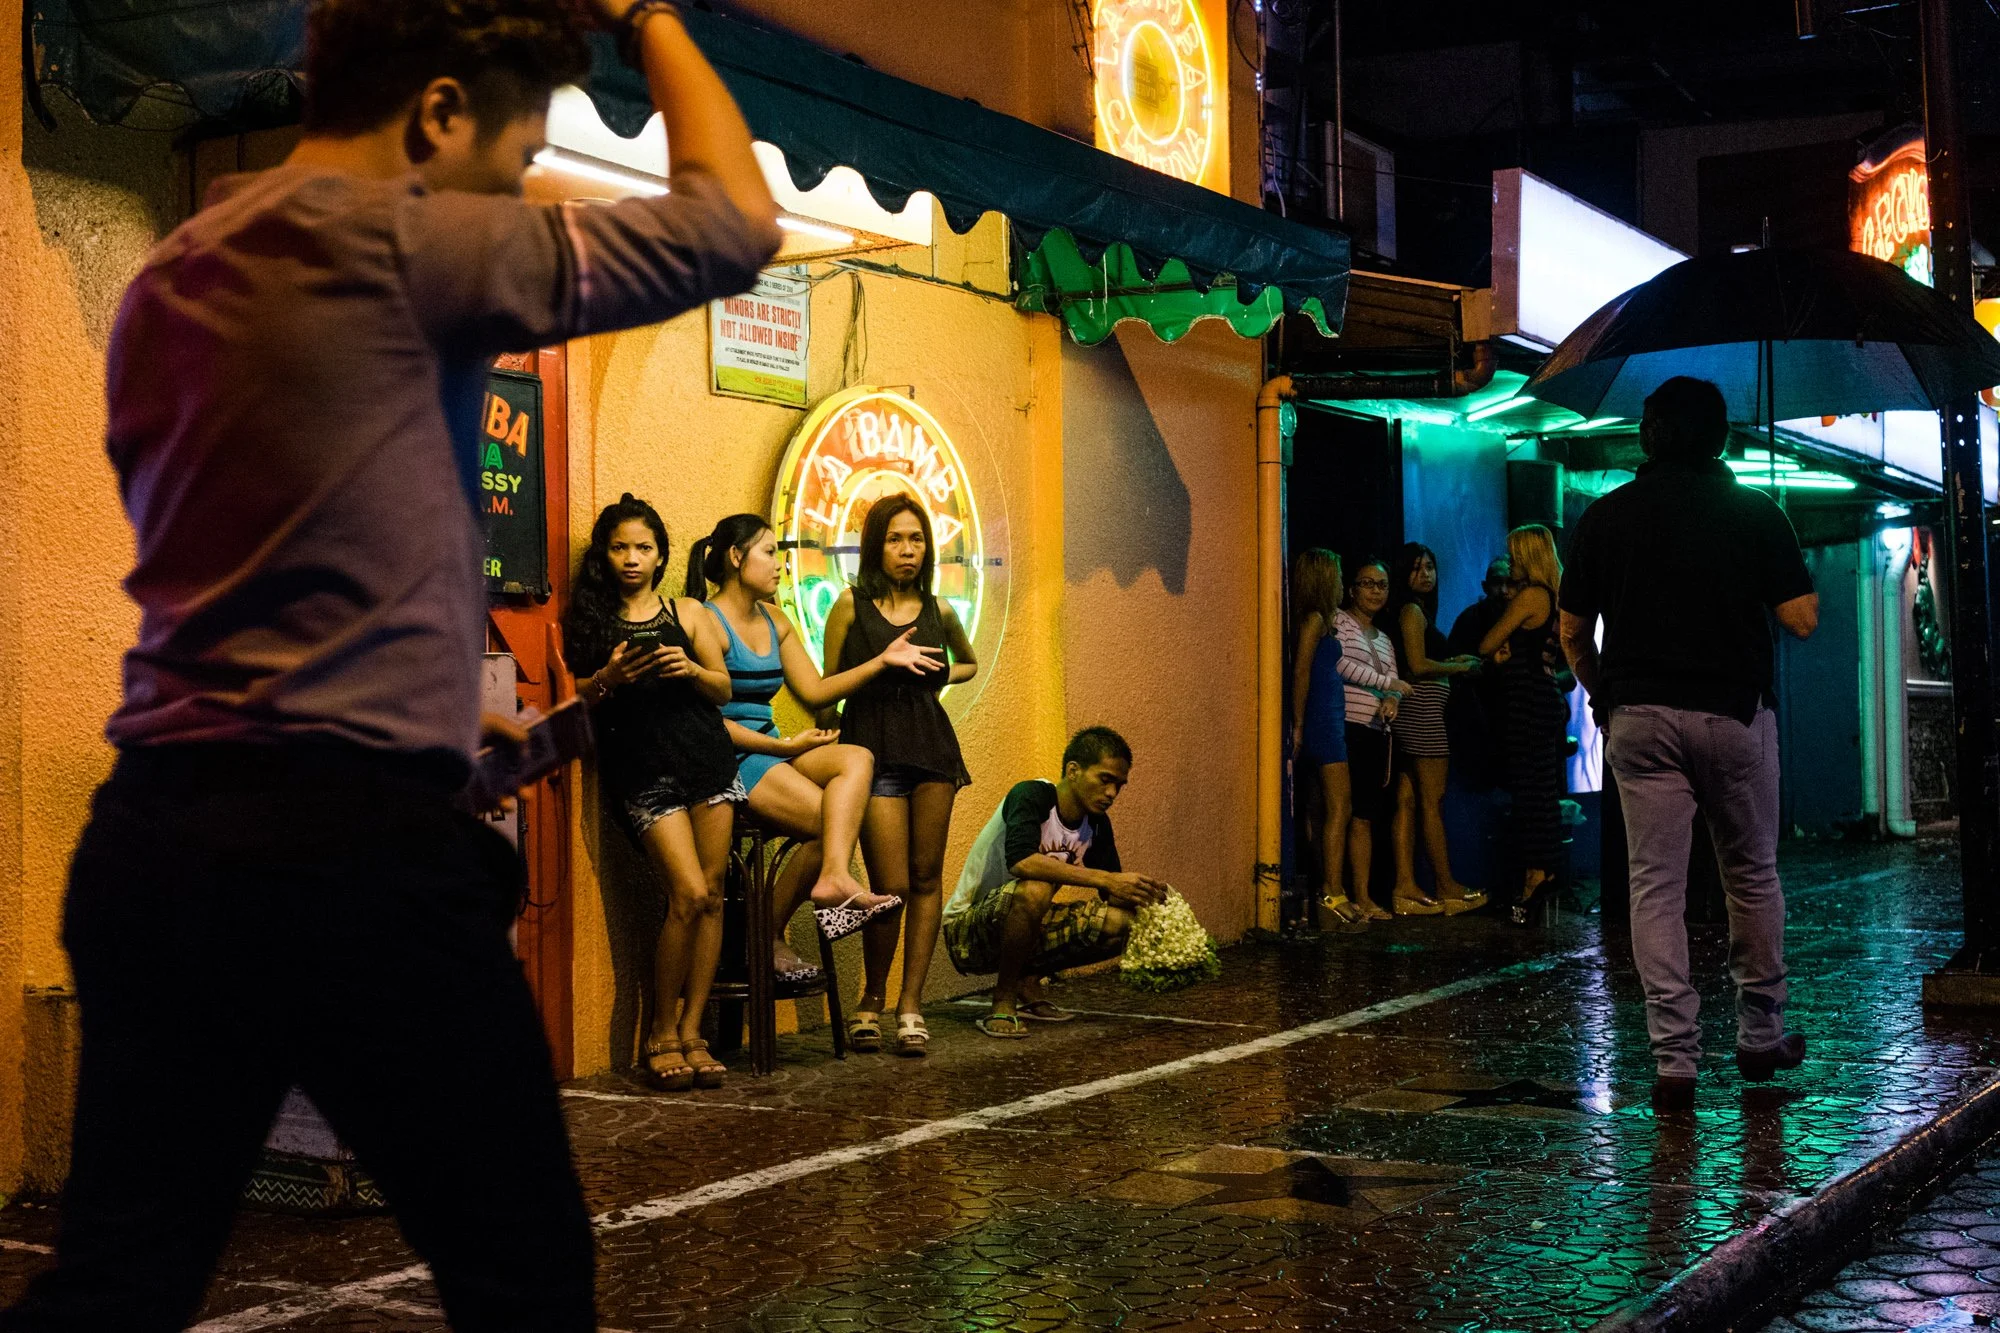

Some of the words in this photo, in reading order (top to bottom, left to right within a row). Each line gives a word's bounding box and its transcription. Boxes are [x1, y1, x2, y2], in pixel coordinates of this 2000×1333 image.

[720, 319, 737, 339] NOT
[739, 322, 773, 346] ALLOWED
[757, 302, 770, 322] ARE
[771, 305, 802, 329] STRICTLY
[481, 391, 530, 458] BA
[804, 454, 853, 529] LA
[856, 411, 964, 547] BAMBA
